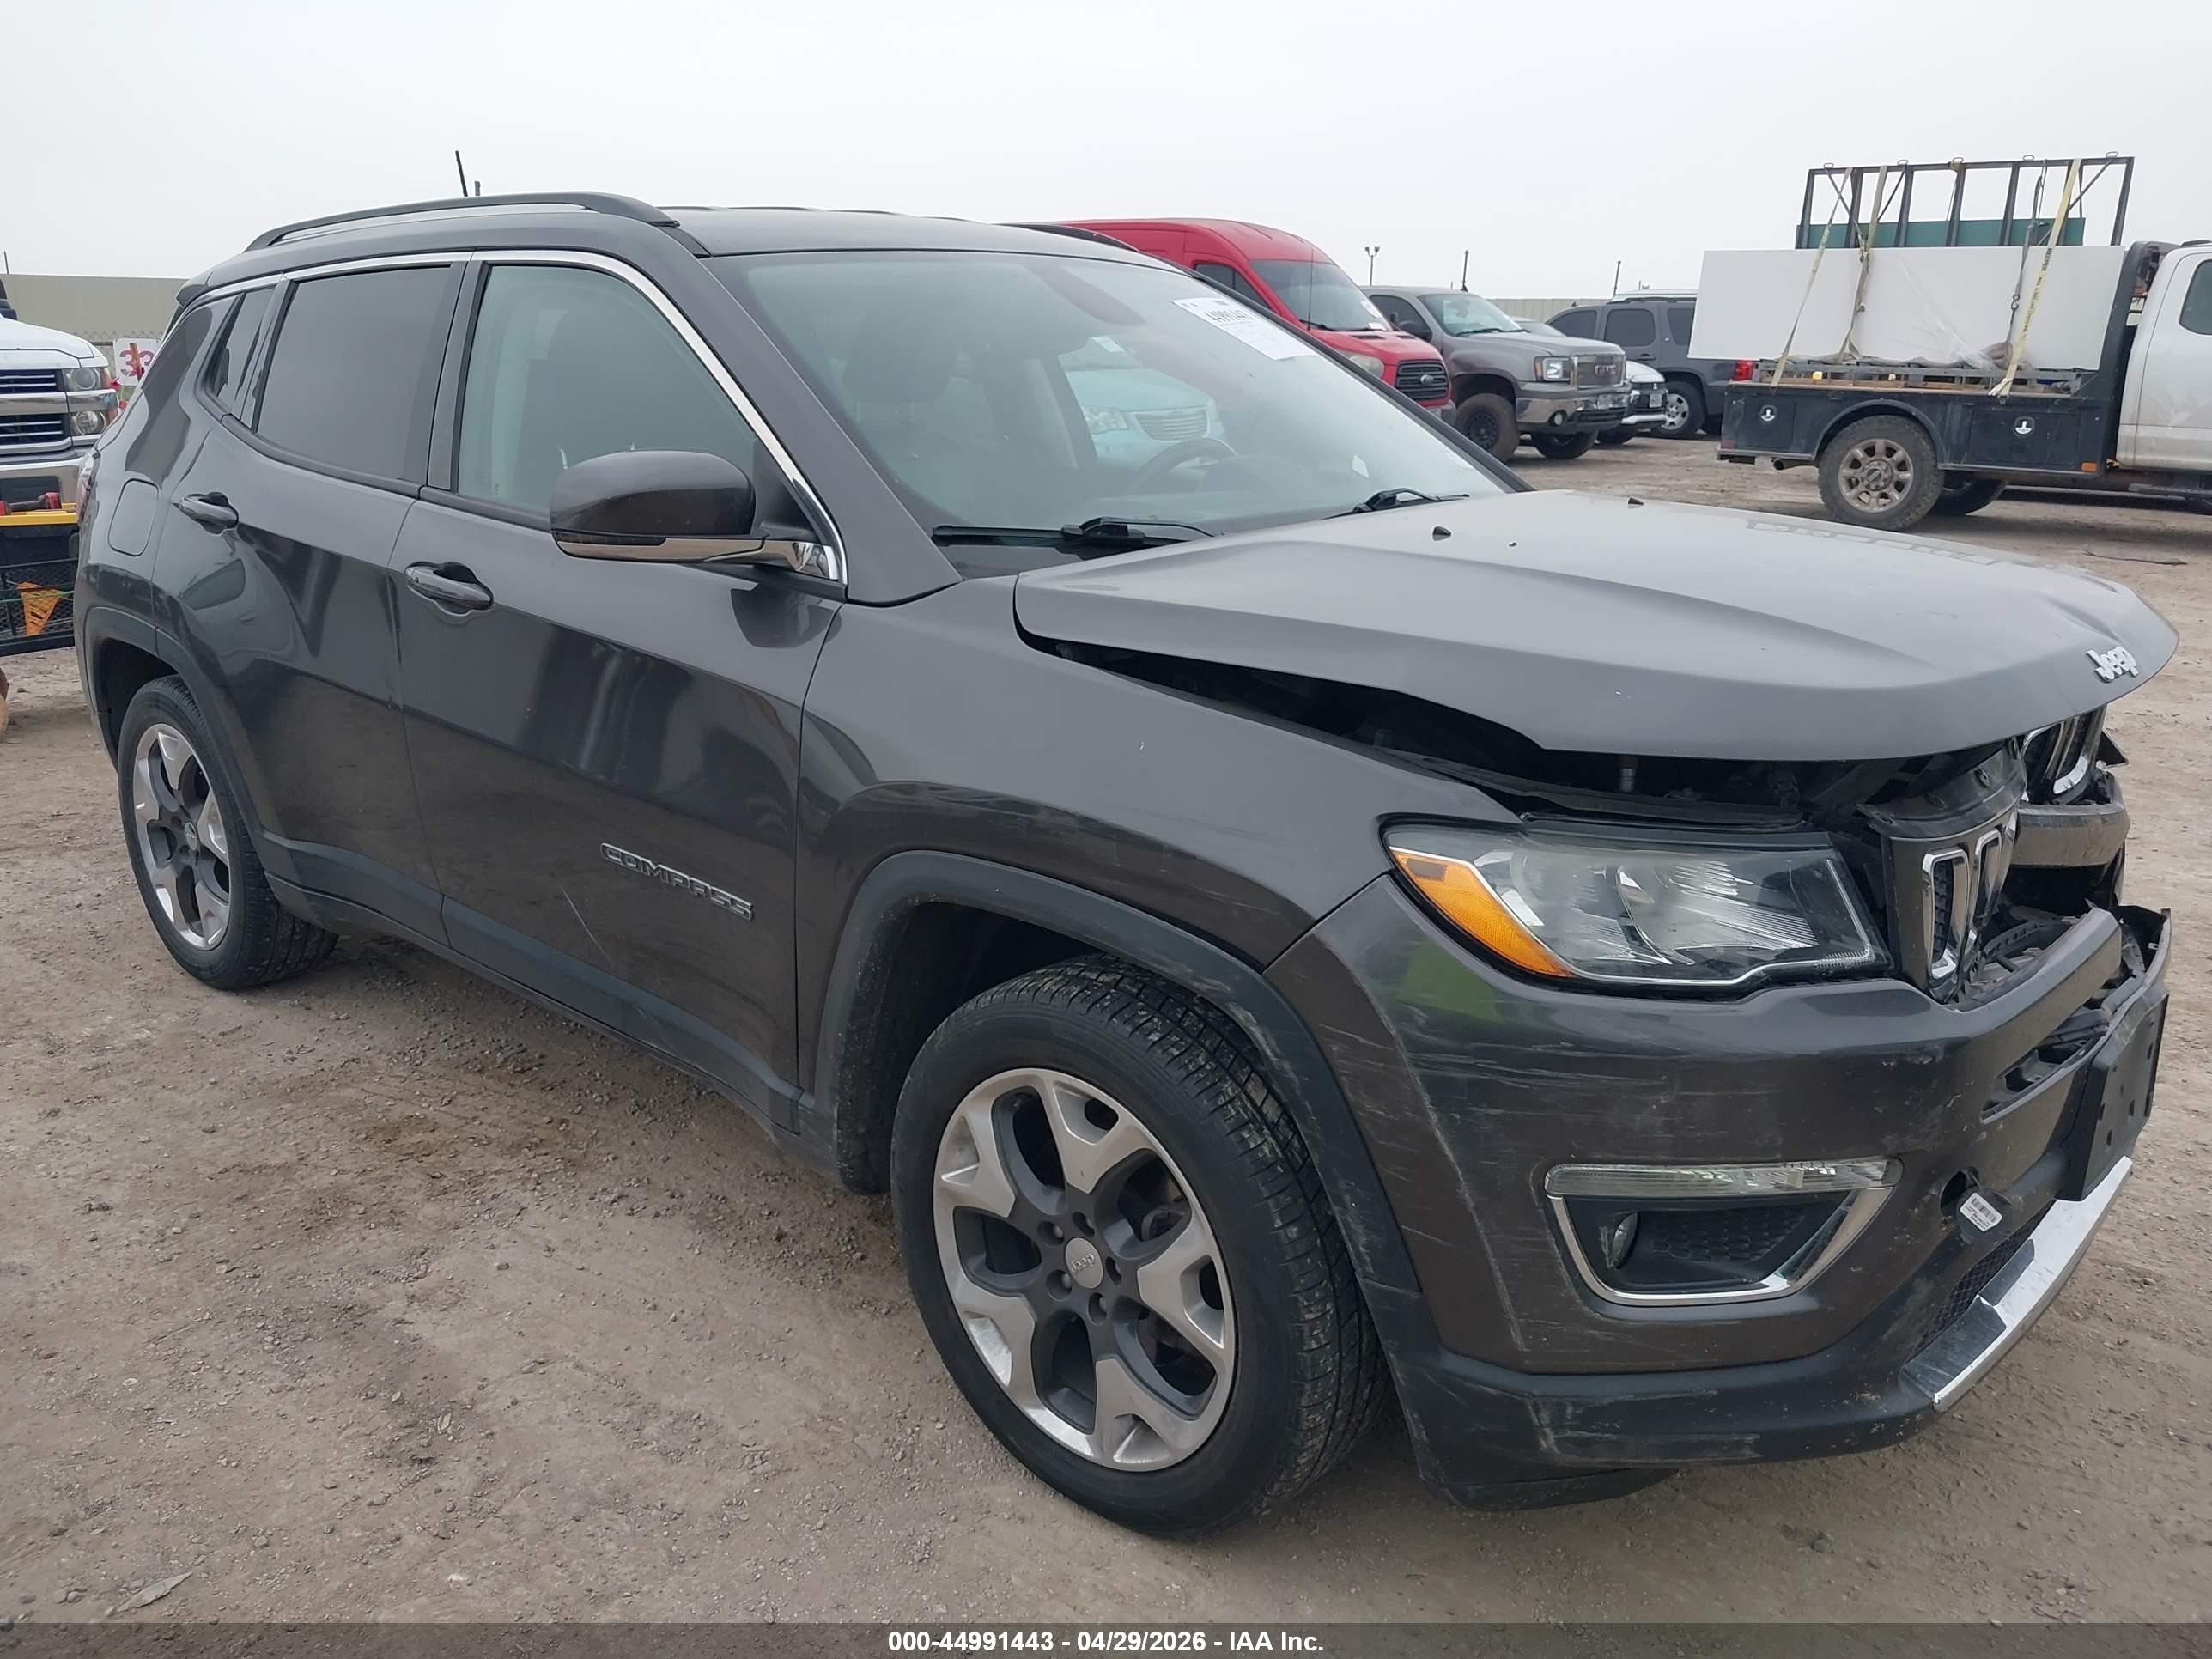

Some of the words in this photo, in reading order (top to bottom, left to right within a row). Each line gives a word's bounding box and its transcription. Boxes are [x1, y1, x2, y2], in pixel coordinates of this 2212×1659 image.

[2086, 647, 2138, 681] Jeep
[600, 842, 754, 921] COMPASS
[1071, 1253, 1095, 1273] Jeep
